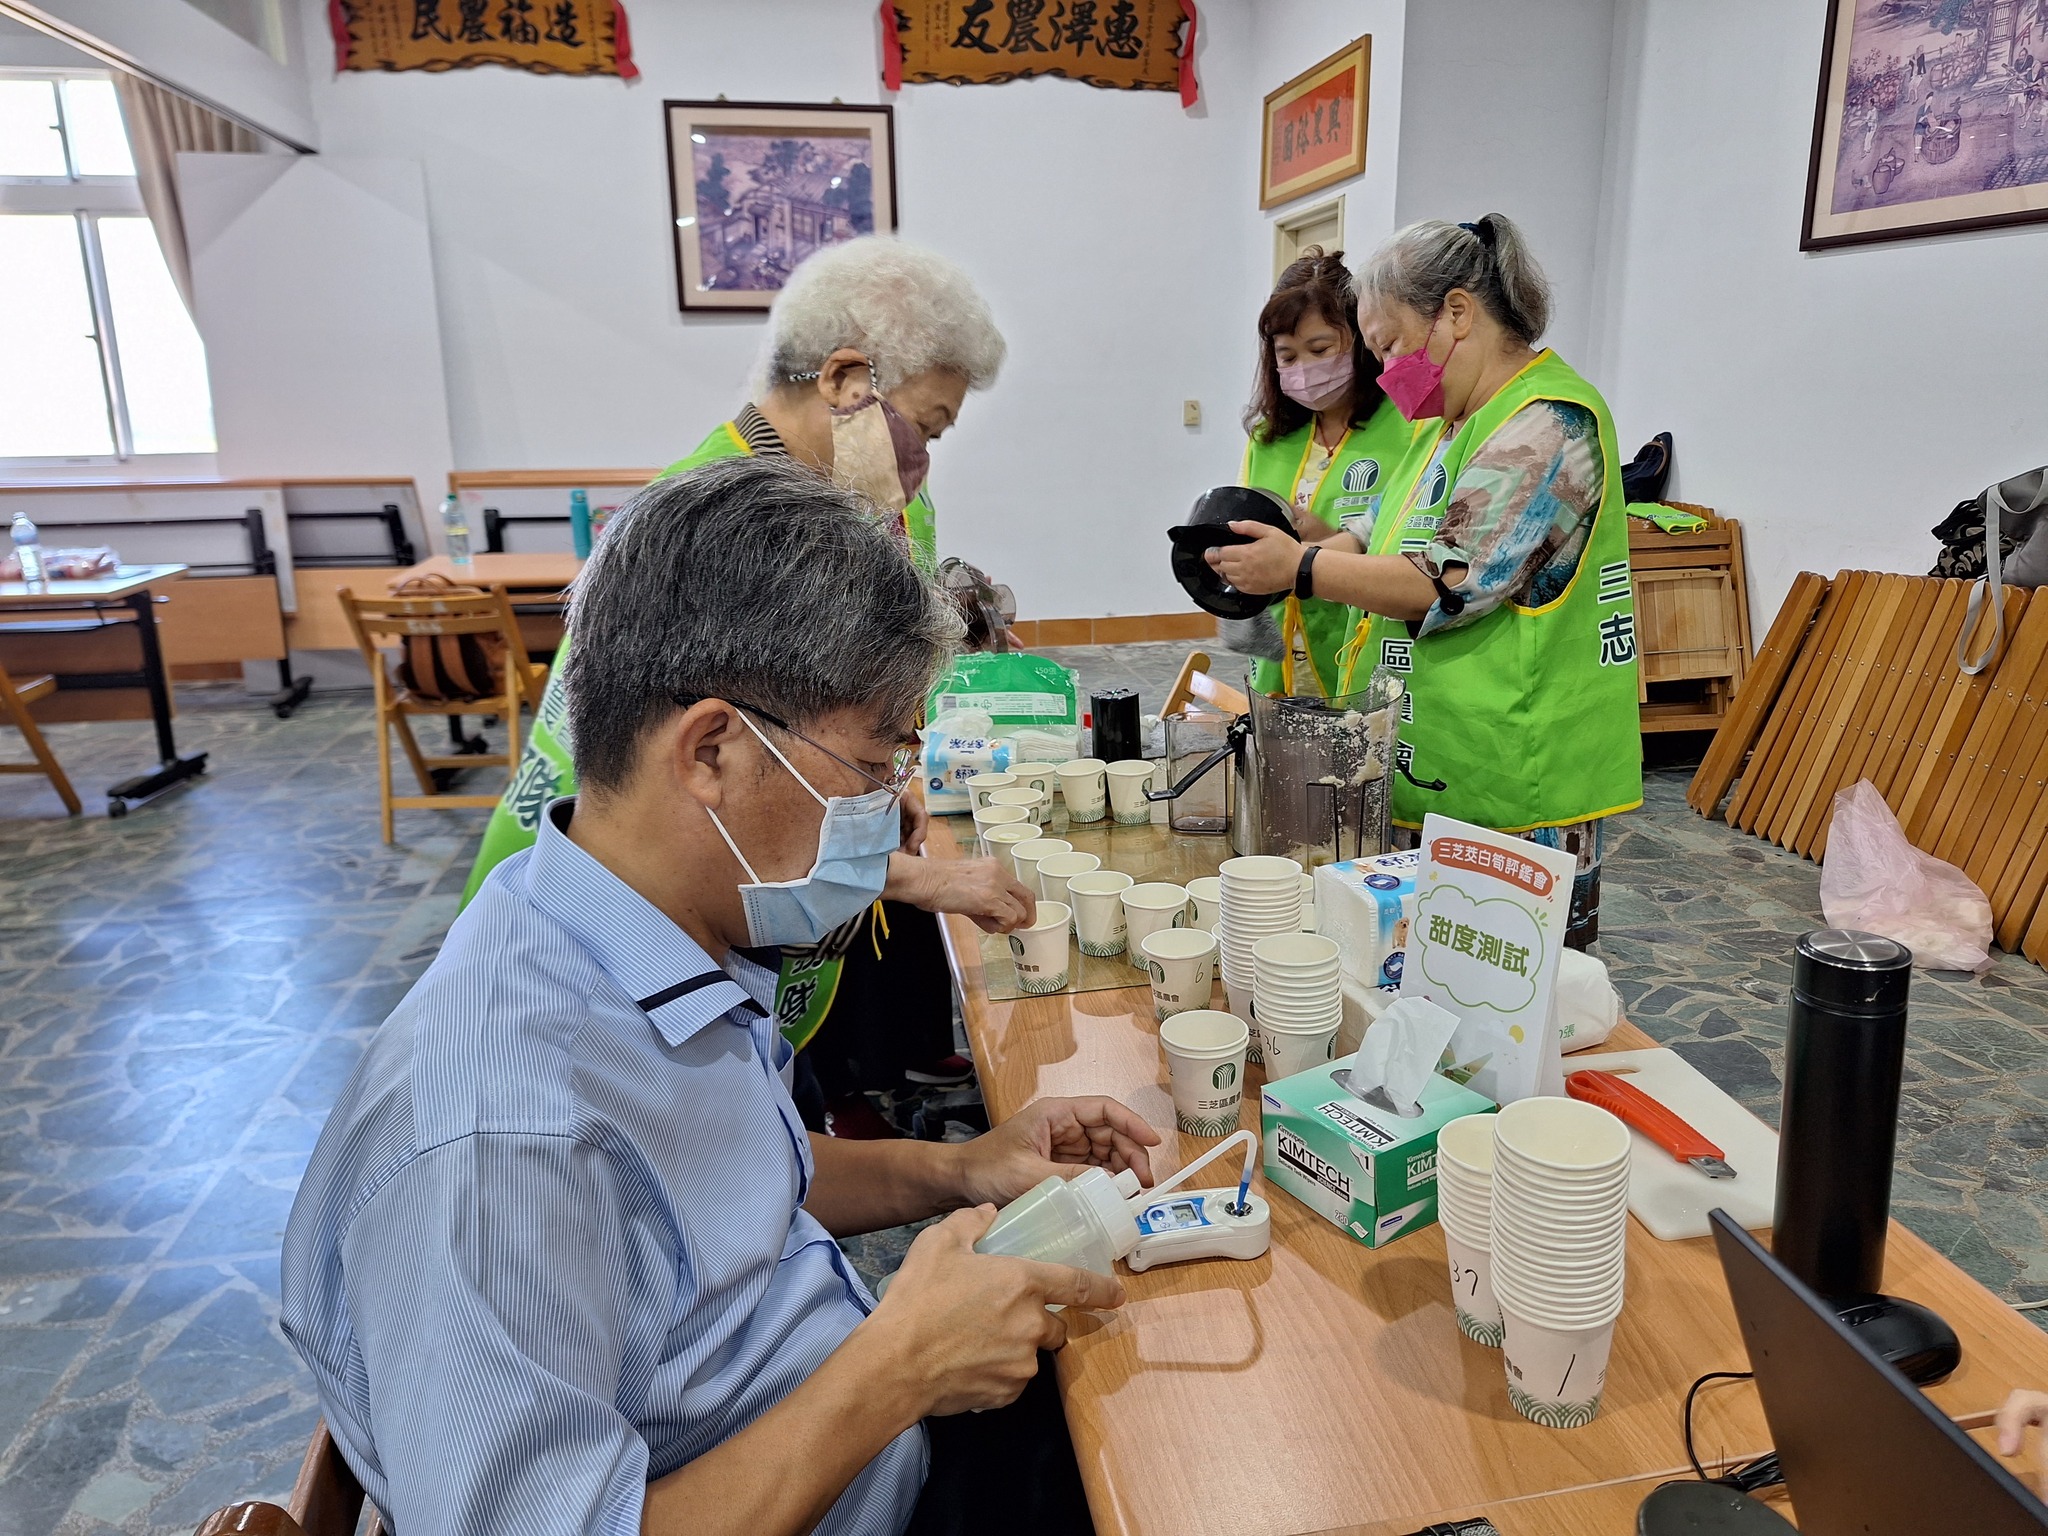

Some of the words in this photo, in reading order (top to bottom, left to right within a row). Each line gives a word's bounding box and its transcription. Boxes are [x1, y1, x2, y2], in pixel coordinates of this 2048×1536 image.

[1438, 841, 1548, 891] 三芝茭白筍評鑑會
[1428, 914, 1530, 978] 甜度測試
[1195, 962, 1204, 984] 6
[1264, 1034, 1281, 1056] 36
[1317, 1104, 1389, 1148] KIMTECH
[1277, 1132, 1350, 1193] KIMTECH
[1364, 1155, 1370, 1171] 1
[1334, 1209, 1349, 1227] 280
[1453, 1259, 1479, 1297] 37
